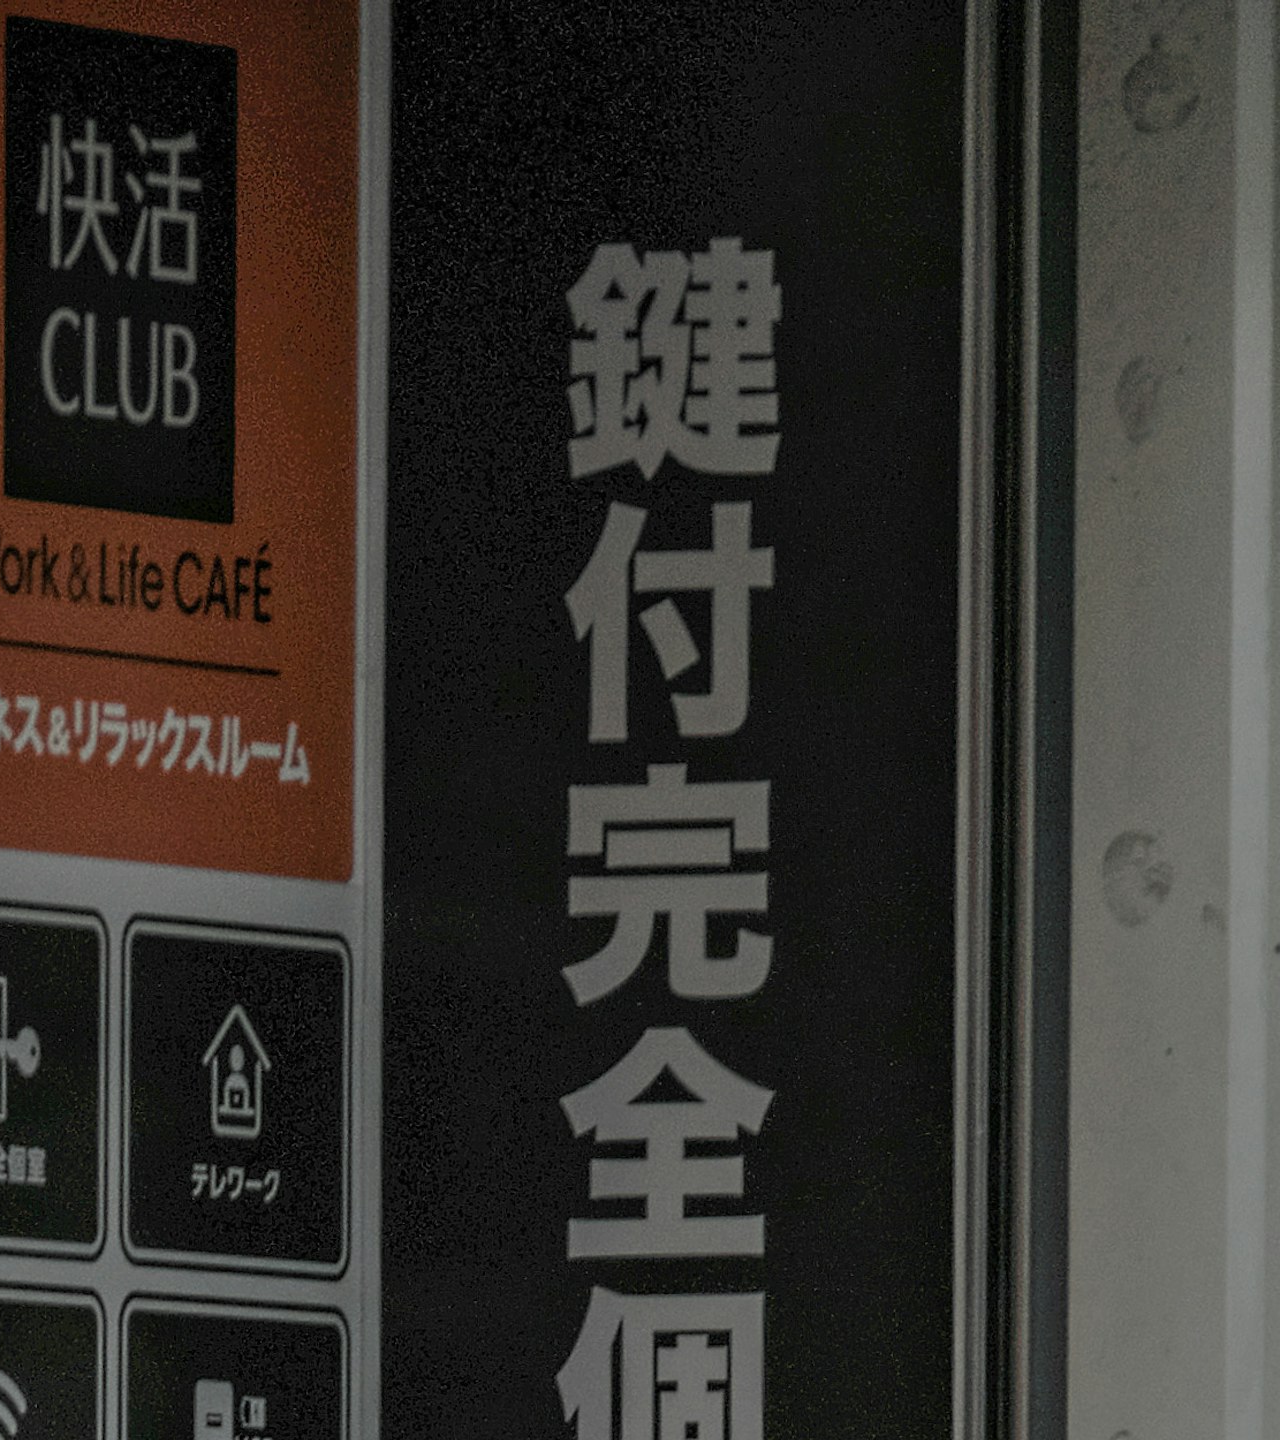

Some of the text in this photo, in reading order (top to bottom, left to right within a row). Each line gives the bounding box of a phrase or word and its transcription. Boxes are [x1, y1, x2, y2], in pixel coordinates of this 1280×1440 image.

[38, 112, 204, 286] 快活
[40, 306, 201, 430] CLUB
[66, 541, 95, 601] &
[98, 536, 165, 612] Life
[171, 541, 275, 627] CAFÉ
[191, 1163, 282, 1204] テレワーク
